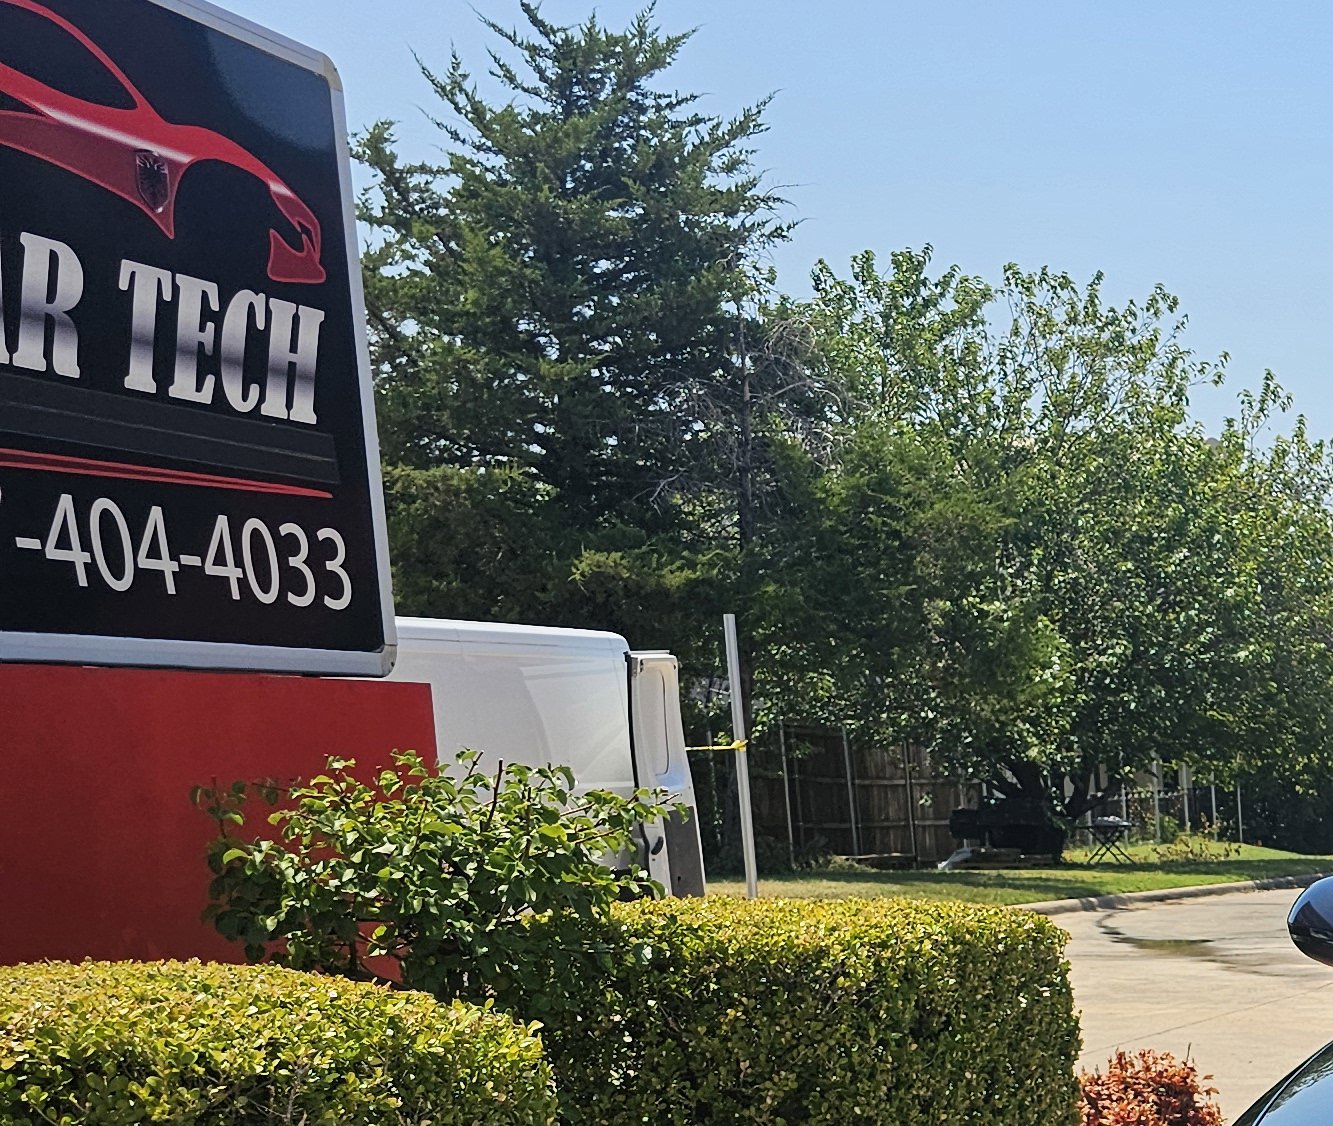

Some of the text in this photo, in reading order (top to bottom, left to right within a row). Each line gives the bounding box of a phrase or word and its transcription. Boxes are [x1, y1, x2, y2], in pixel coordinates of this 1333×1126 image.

[0, 231, 326, 424] R TECH
[0, 493, 353, 610] -404-4033
